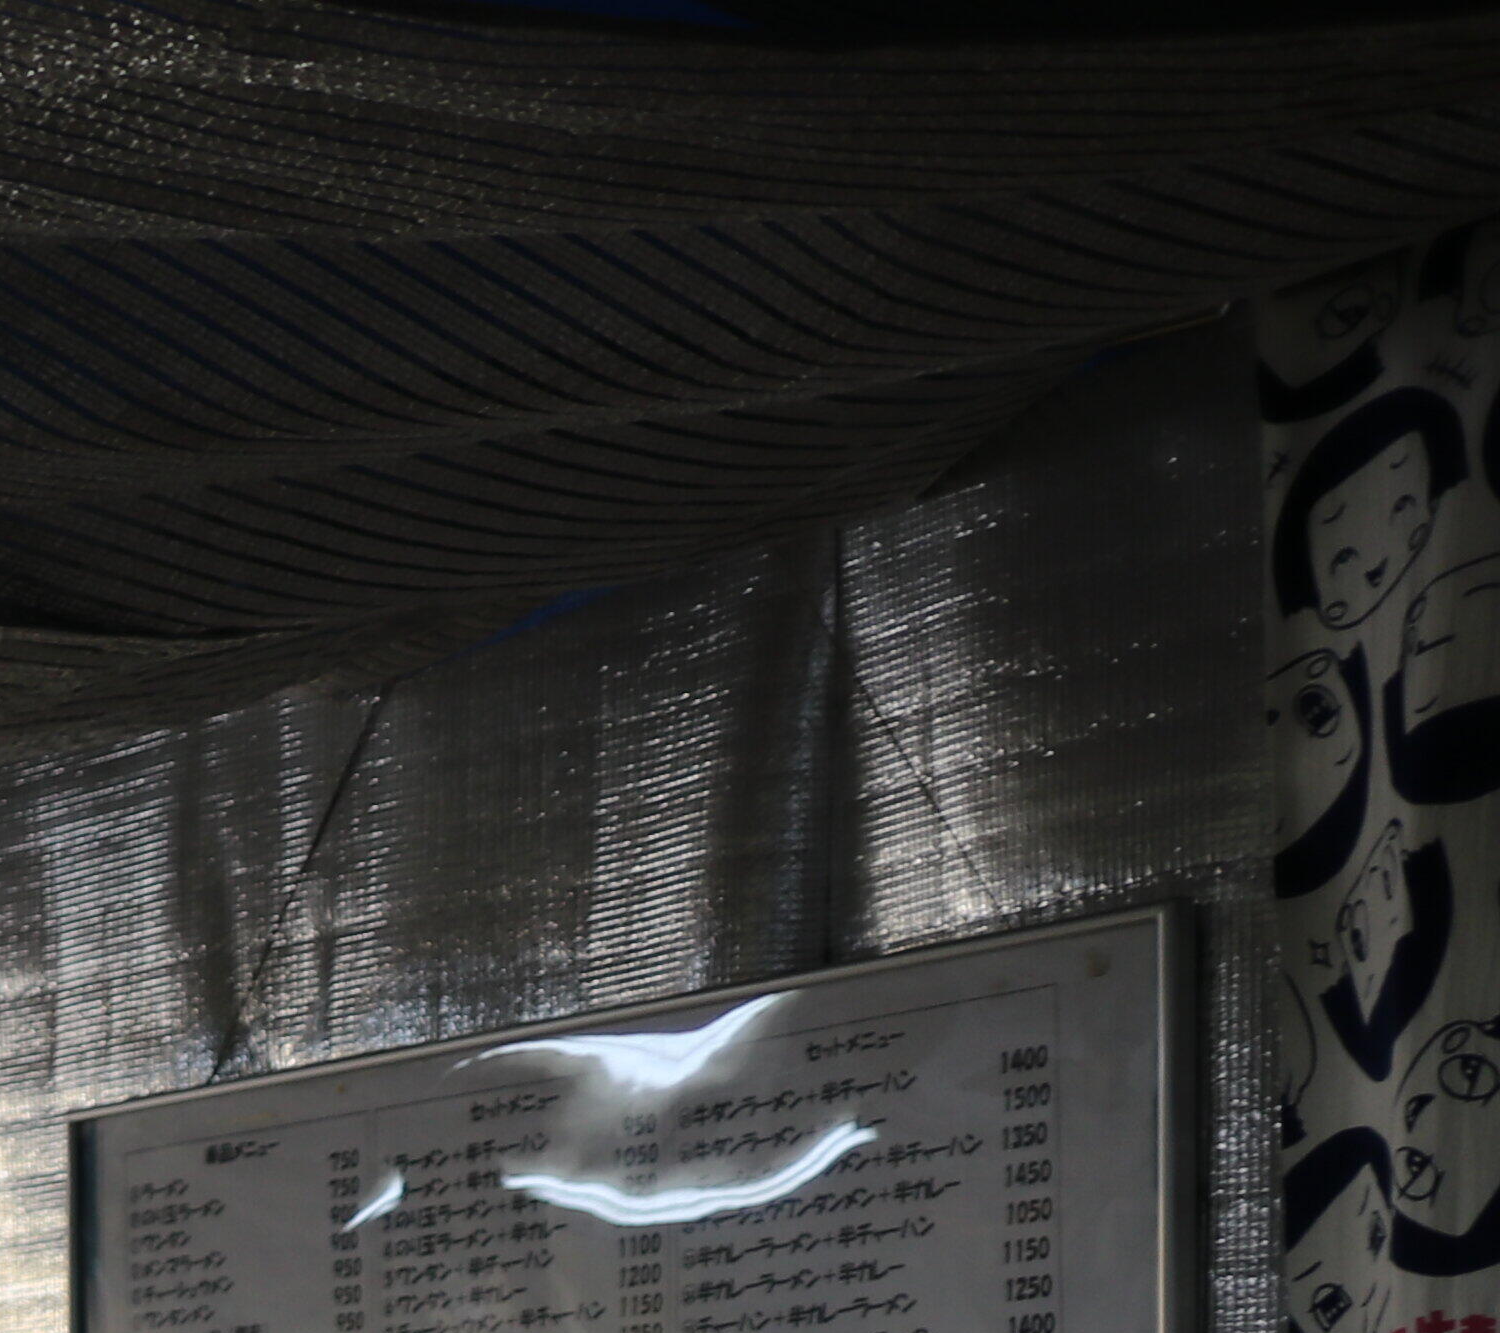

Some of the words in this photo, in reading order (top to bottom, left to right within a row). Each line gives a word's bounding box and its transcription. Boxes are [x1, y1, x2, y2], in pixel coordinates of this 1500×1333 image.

[805, 1032, 905, 1062] セットメニュー
[999, 1045, 1048, 1075] 1400
[1003, 1083, 1051, 1111] 1500
[1001, 1123, 1047, 1150] 1350
[1005, 1160, 1052, 1186] 1450
[1006, 1198, 1052, 1224] 1050
[619, 1233, 661, 1258] 1100
[1002, 1236, 1050, 1264] 1150
[619, 1265, 662, 1287] 1200
[1005, 1275, 1052, 1302] 1250
[619, 1294, 664, 1316] 1150
